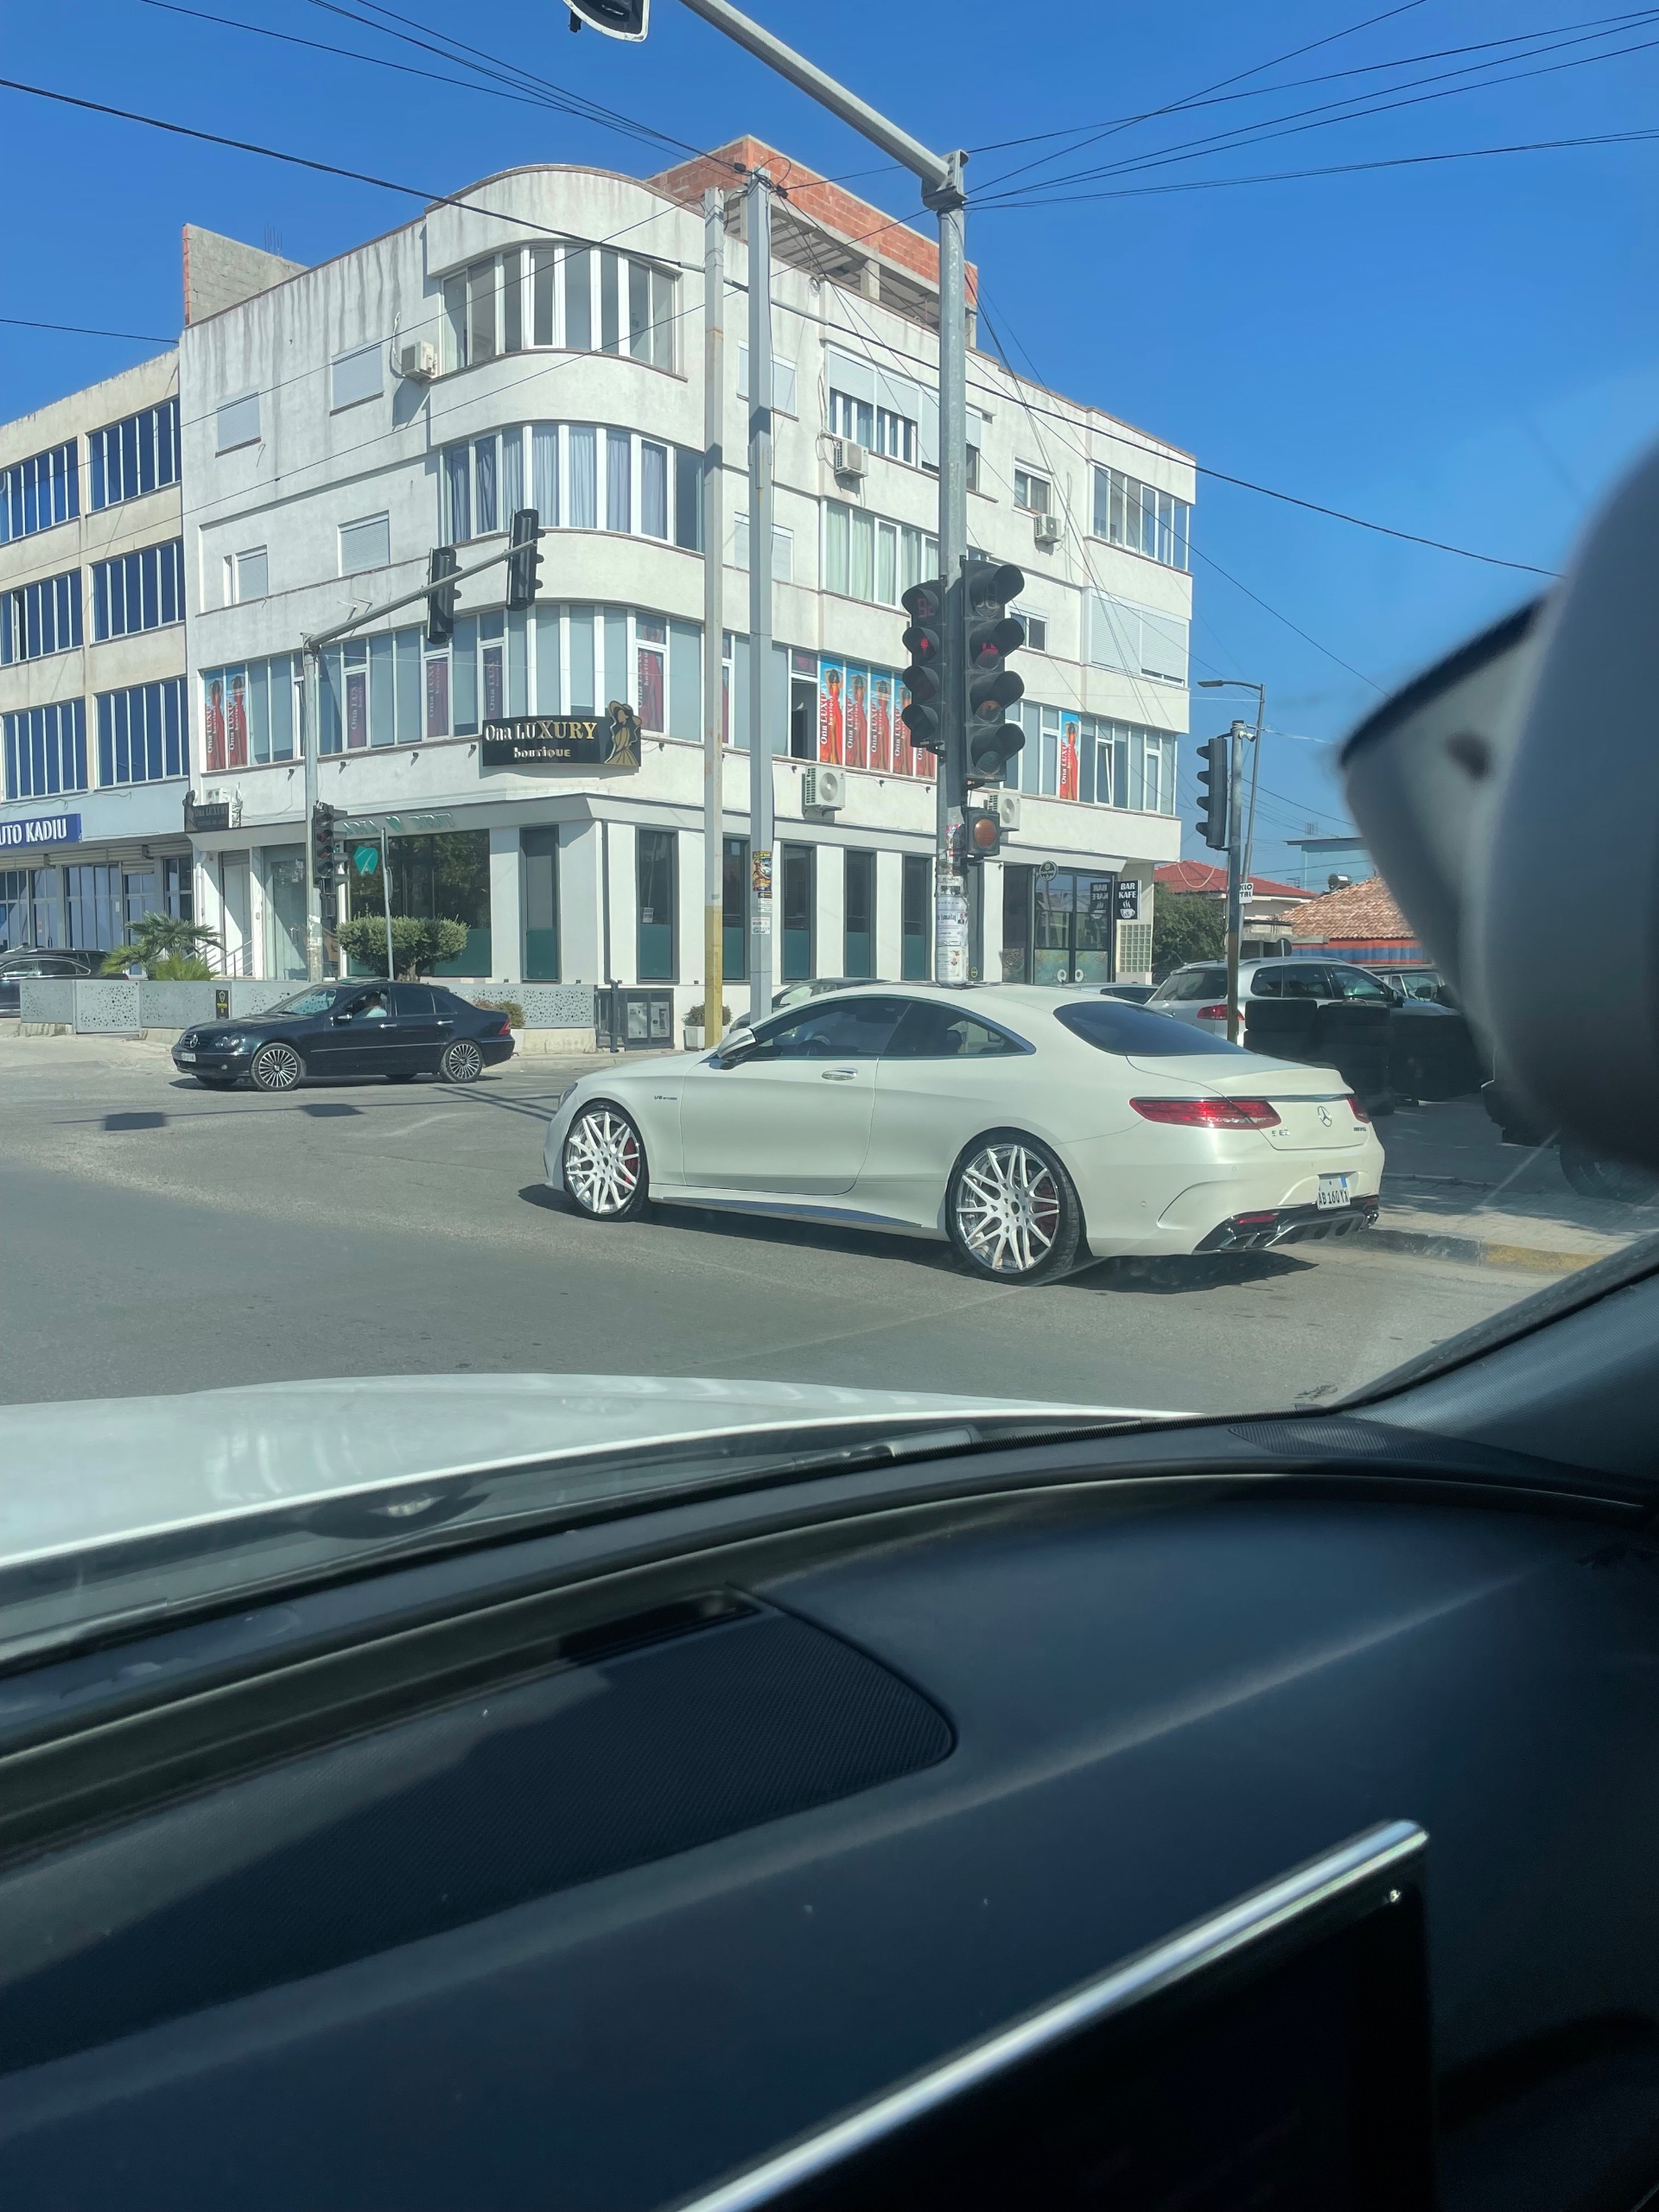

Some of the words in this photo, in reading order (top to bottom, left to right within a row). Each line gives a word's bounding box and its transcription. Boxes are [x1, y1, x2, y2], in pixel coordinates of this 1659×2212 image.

[486, 724, 512, 741] Ona
[514, 720, 598, 740] LUXURY
[513, 746, 570, 759] boutique
[25, 818, 67, 842] KADIU
[1120, 882, 1135, 891] BAR
[1118, 890, 1137, 899] KAFE
